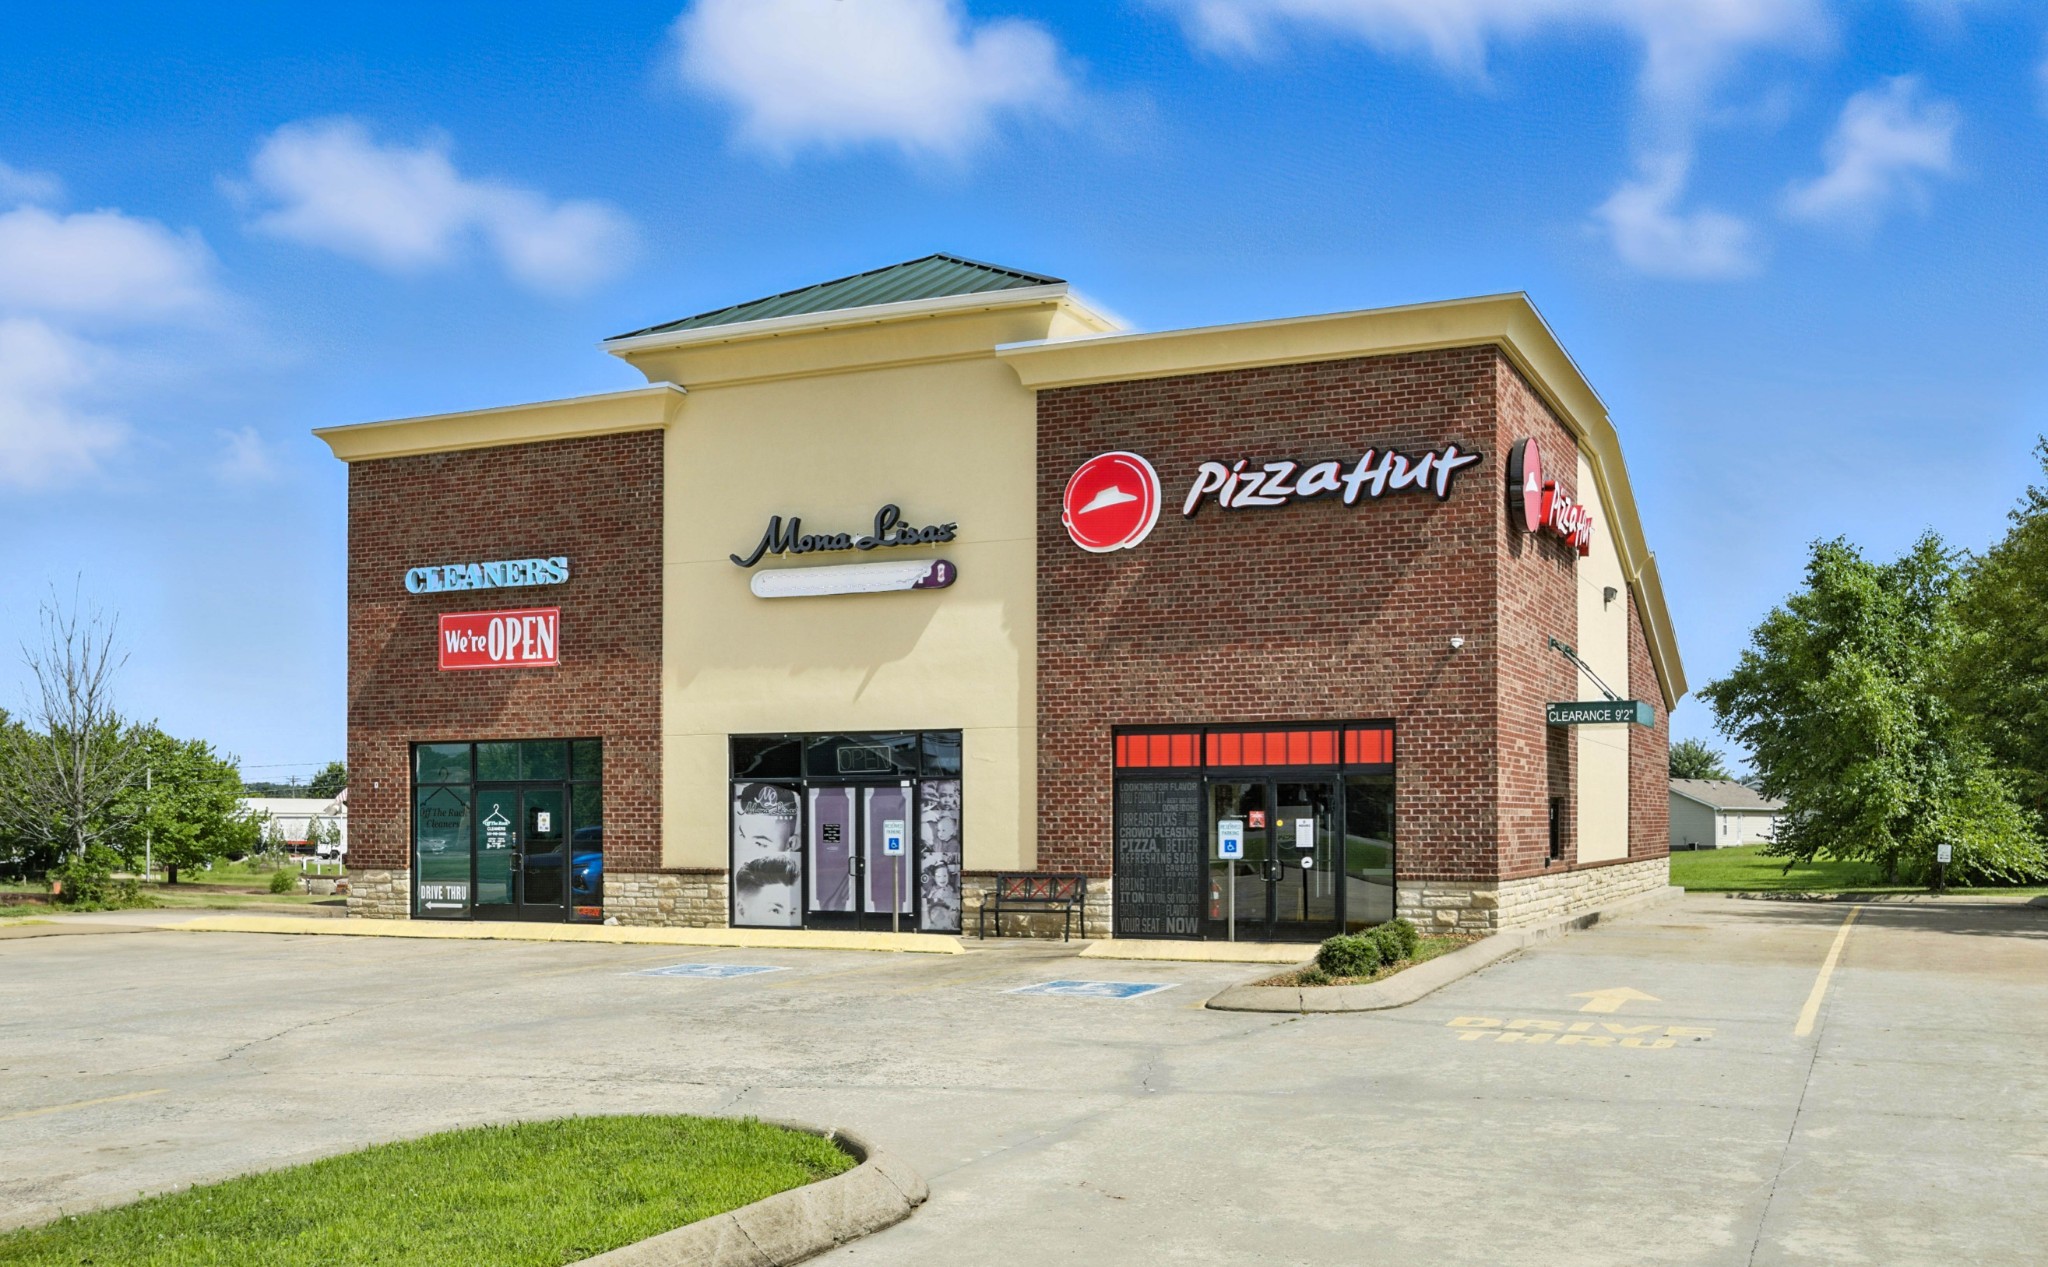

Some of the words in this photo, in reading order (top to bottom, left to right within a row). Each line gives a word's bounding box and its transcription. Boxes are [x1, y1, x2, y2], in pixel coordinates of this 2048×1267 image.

[729, 515, 854, 568] Mona
[405, 557, 569, 594] CLEANERS
[445, 629, 487, 654] We're
[488, 615, 554, 662] OPEN
[1548, 709, 1611, 723] CLEARANCE
[1615, 708, 1634, 721] 9'2"
[840, 748, 889, 770] OPEN
[1120, 783, 1154, 792] LOOKING
[1155, 783, 1169, 791] FOR
[1170, 782, 1198, 791] FLAVOR
[1120, 791, 1133, 804] YOU
[1134, 791, 1157, 804] FOUND
[433, 807, 447, 817] The
[1123, 812, 1177, 827] BREADSTICKS
[1120, 827, 1153, 838] CROWD
[1154, 827, 1199, 838] PLEASING
[1166, 838, 1198, 853] BETTER
[1120, 853, 1171, 864] REFRESHING
[1173, 853, 1198, 864] SODA
[1166, 864, 1199, 872] CRUSHED
[1120, 877, 1145, 892] BRING
[420, 885, 443, 900] DRIVE
[446, 885, 467, 900] THRU
[1120, 892, 1130, 903] IT
[1131, 892, 1145, 903] ON
[1120, 917, 1141, 933] YOUR
[1142, 917, 1160, 933] SEAT
[1166, 917, 1199, 933] NOW
[1445, 1016, 1716, 1038] DRIVE
[1455, 1030, 1677, 1049] THRU
